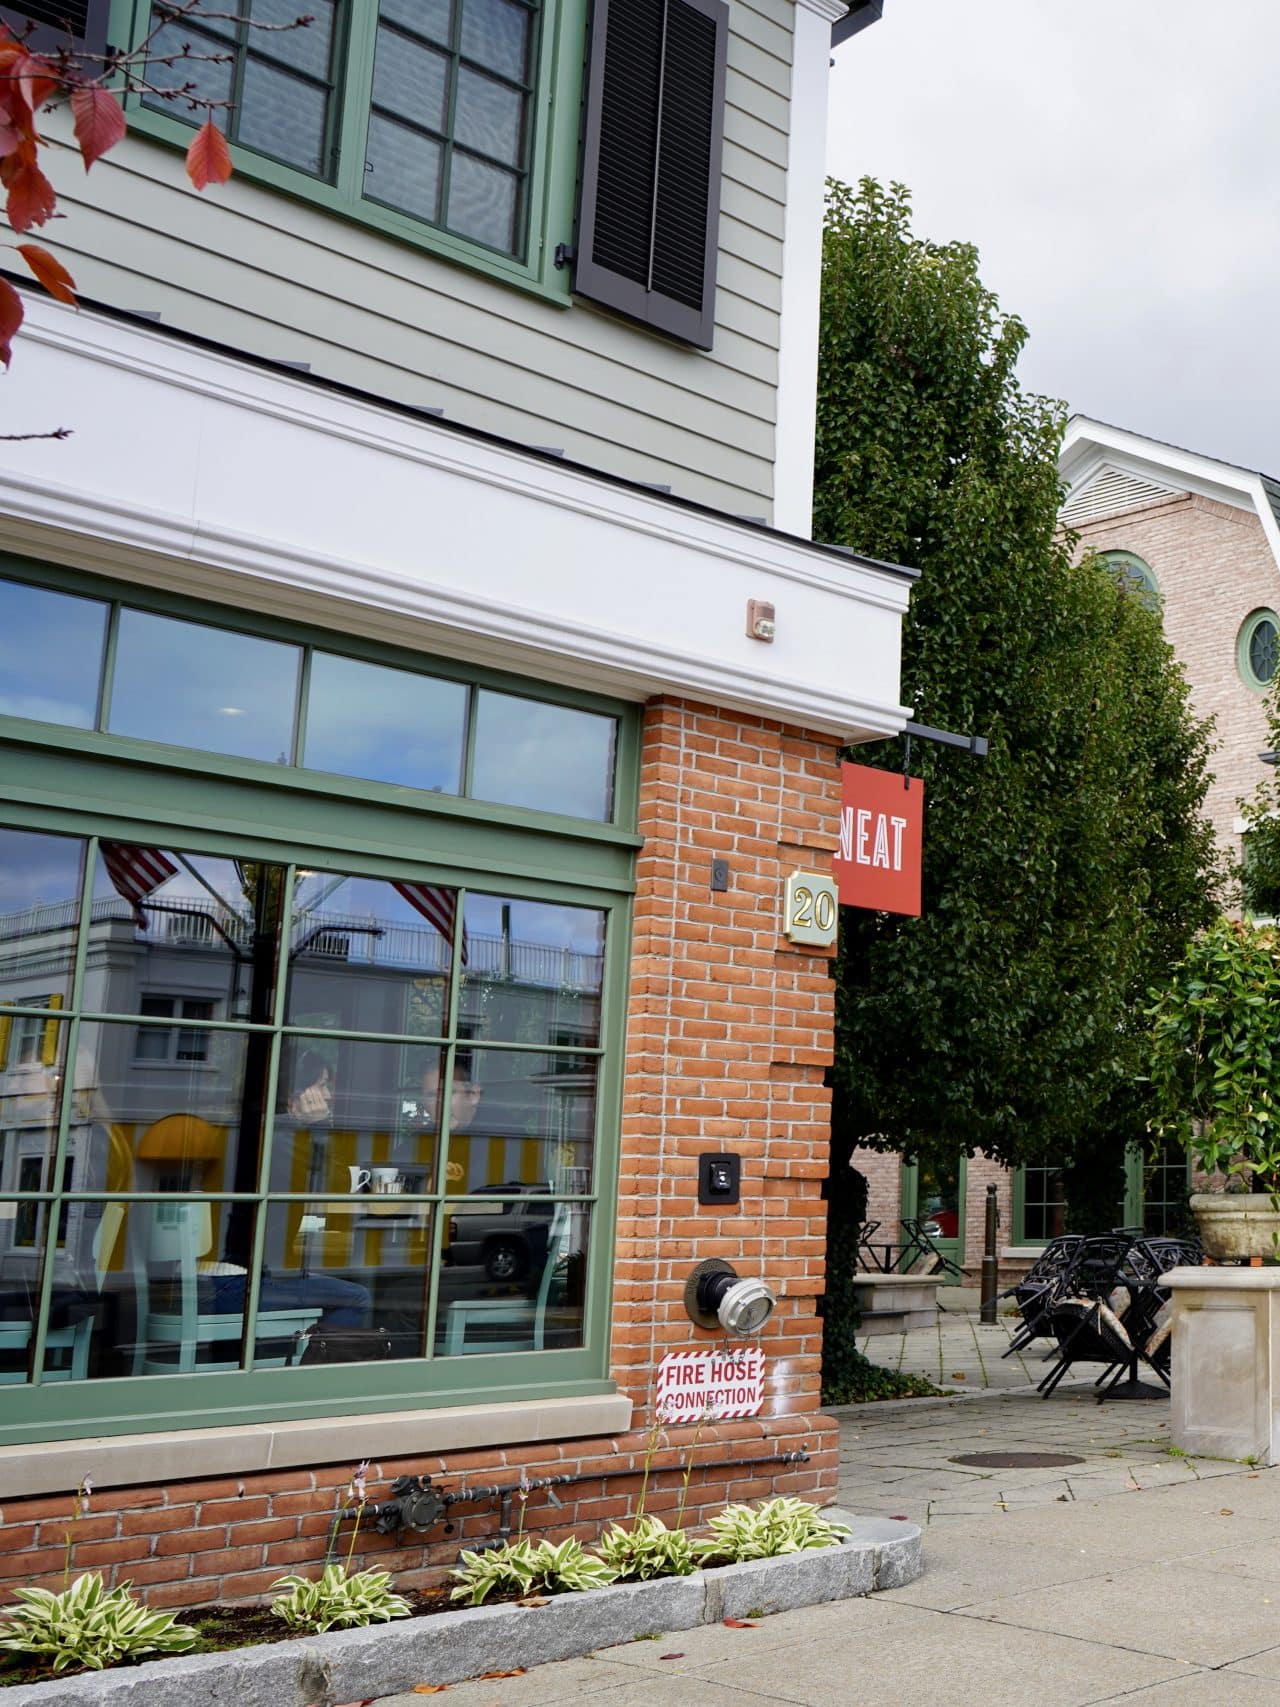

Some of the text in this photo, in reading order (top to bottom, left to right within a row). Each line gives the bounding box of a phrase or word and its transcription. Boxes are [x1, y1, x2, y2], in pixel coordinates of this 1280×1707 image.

[833, 806, 907, 871] NEAT
[792, 886, 835, 931] 20
[666, 1360, 758, 1386] FIRE HOSE
[665, 1387, 756, 1410] CONNECTION
